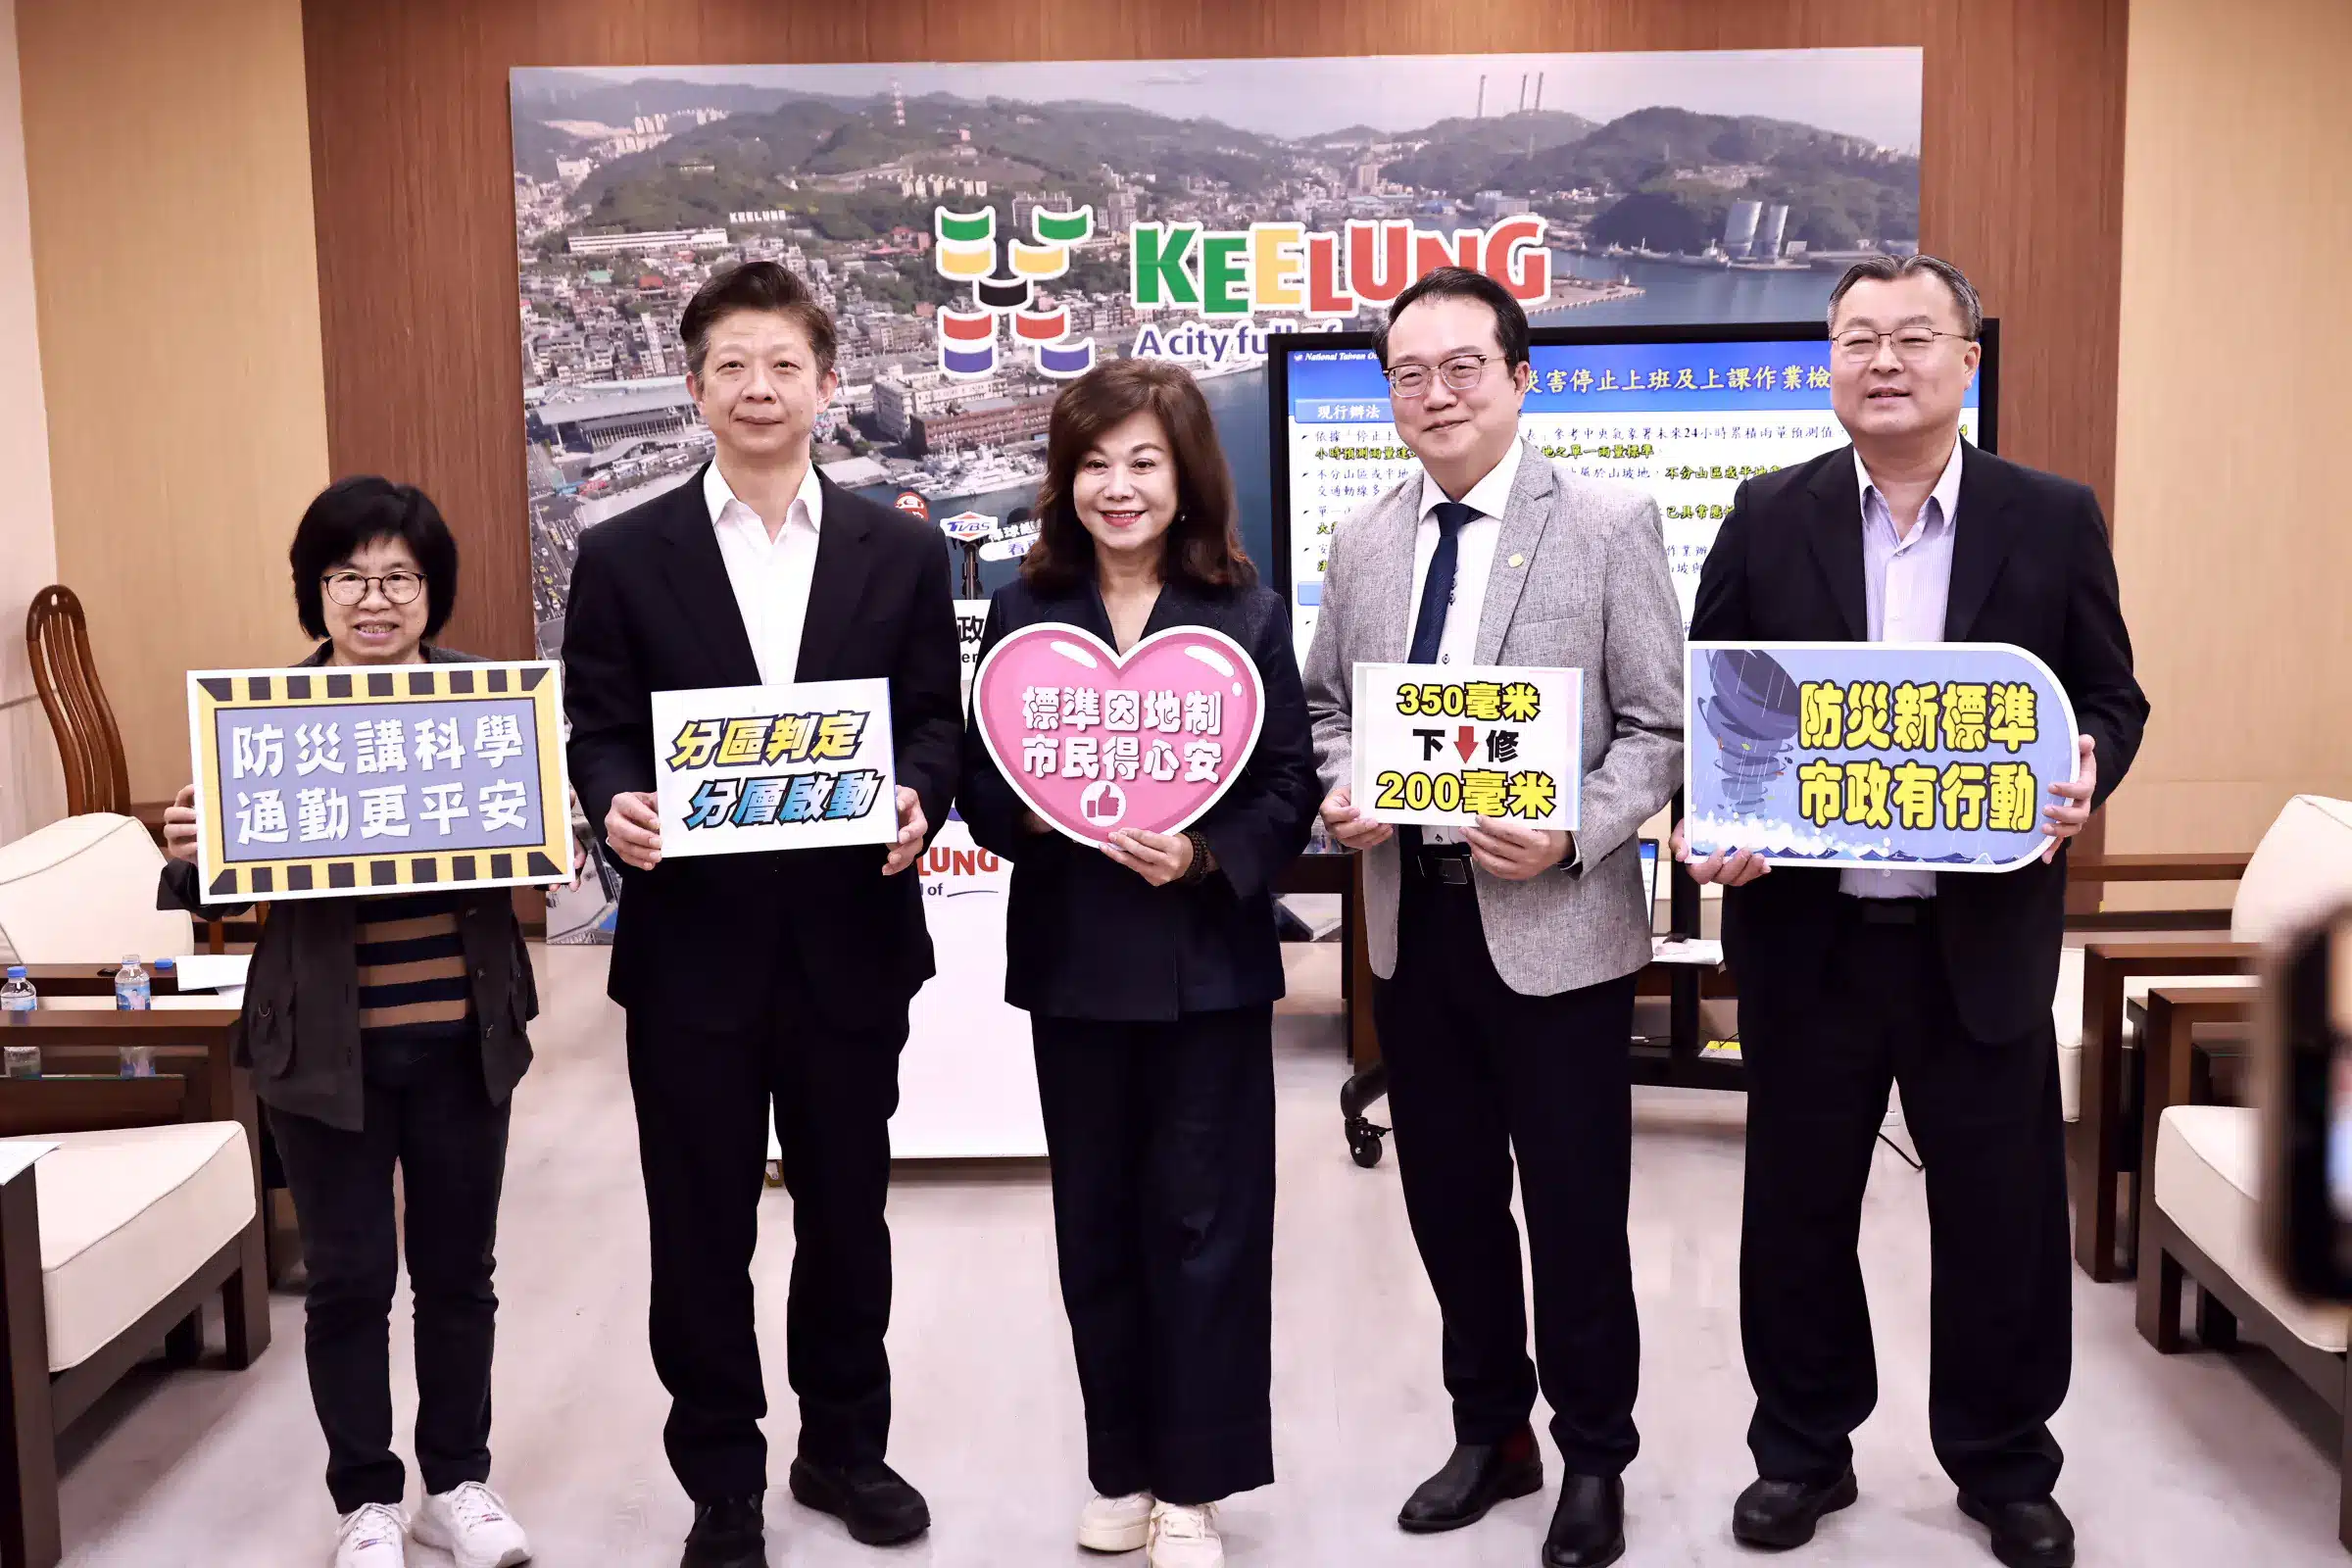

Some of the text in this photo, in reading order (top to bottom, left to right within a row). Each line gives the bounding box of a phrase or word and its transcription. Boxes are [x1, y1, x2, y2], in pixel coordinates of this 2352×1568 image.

[1134, 220, 1547, 313] KEELUNG
[1138, 329, 1170, 355] A
[1173, 325, 1229, 363] city
[1304, 352, 1338, 362] National
[1316, 430, 1399, 443] 依據「停止上
[948, 520, 990, 532] TVBS
[1022, 686, 1222, 735] 標準因地制
[1396, 680, 1542, 723] 350毫米
[1798, 678, 2039, 753] 防災新標準
[231, 713, 524, 779] 防災講科學
[665, 710, 870, 772] 分區判定
[1021, 734, 1222, 784] 市民得心安
[235, 778, 528, 846] 通勤更平安
[682, 768, 886, 831] 分層啟動
[1375, 768, 1557, 820] 200毫米
[1796, 757, 2038, 833] 市政有行動
[927, 882, 944, 896] of
